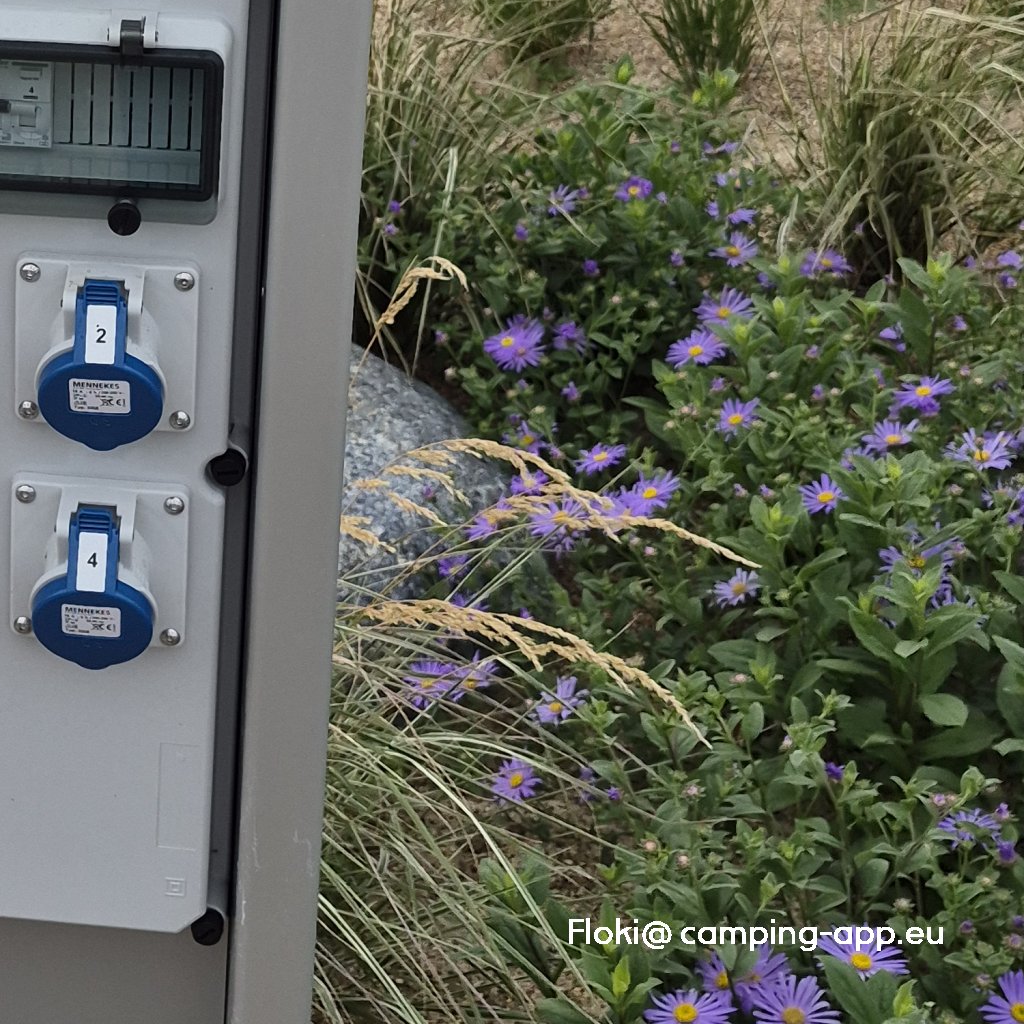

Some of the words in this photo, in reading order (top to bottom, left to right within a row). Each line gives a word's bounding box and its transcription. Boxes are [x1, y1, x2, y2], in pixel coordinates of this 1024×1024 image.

[96, 328, 106, 343] 2
[73, 381, 119, 389] MENNEKES
[87, 553, 97, 567] 4
[65, 607, 110, 615] MENNEKES
